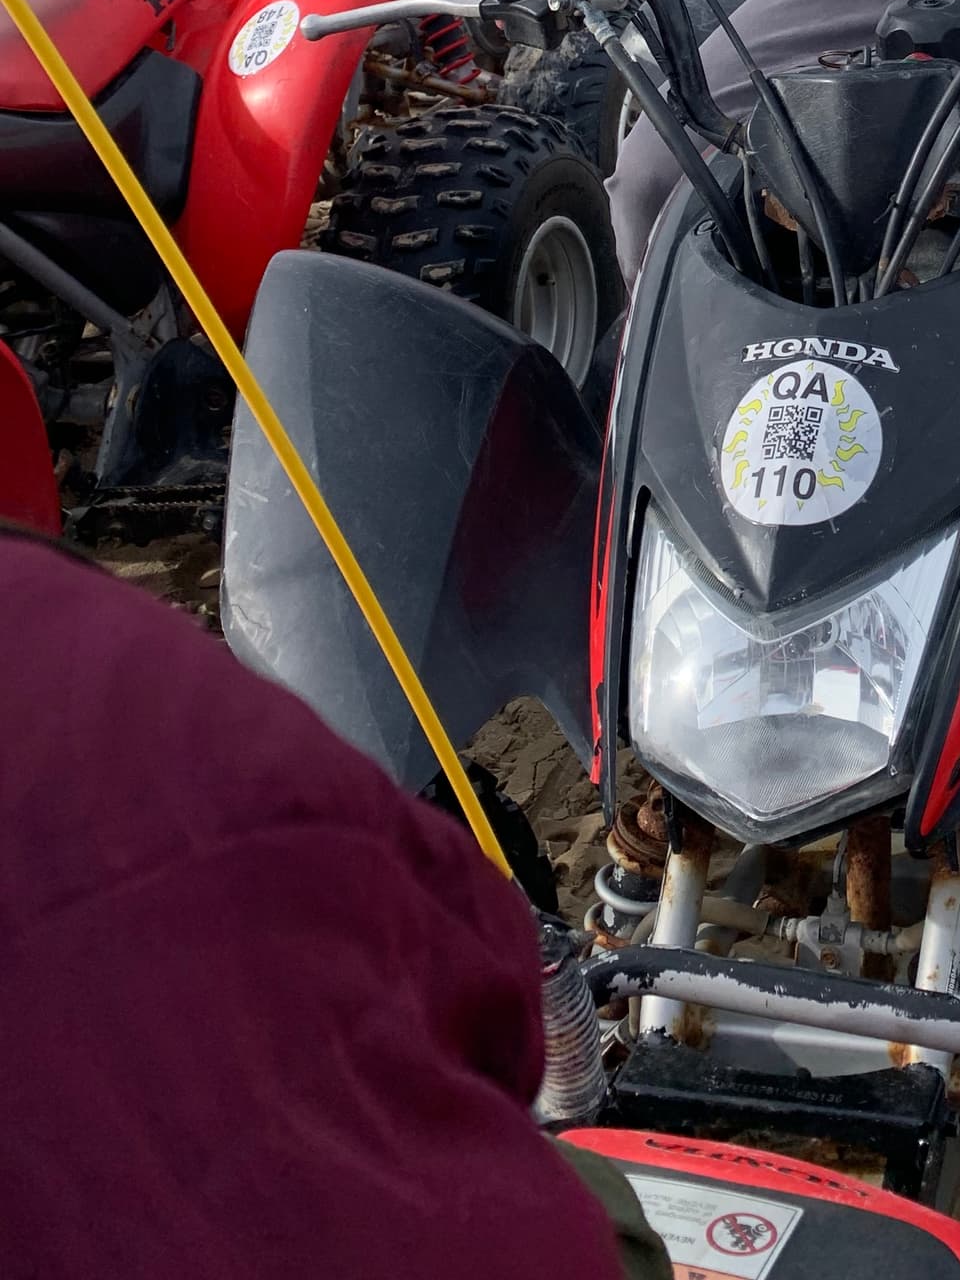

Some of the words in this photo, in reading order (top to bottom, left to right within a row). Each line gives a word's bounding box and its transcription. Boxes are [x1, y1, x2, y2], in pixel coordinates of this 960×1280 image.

[245, 50, 268, 68] QA
[742, 337, 900, 373] HONDA
[772, 371, 829, 403] QA
[752, 465, 817, 500] 110
